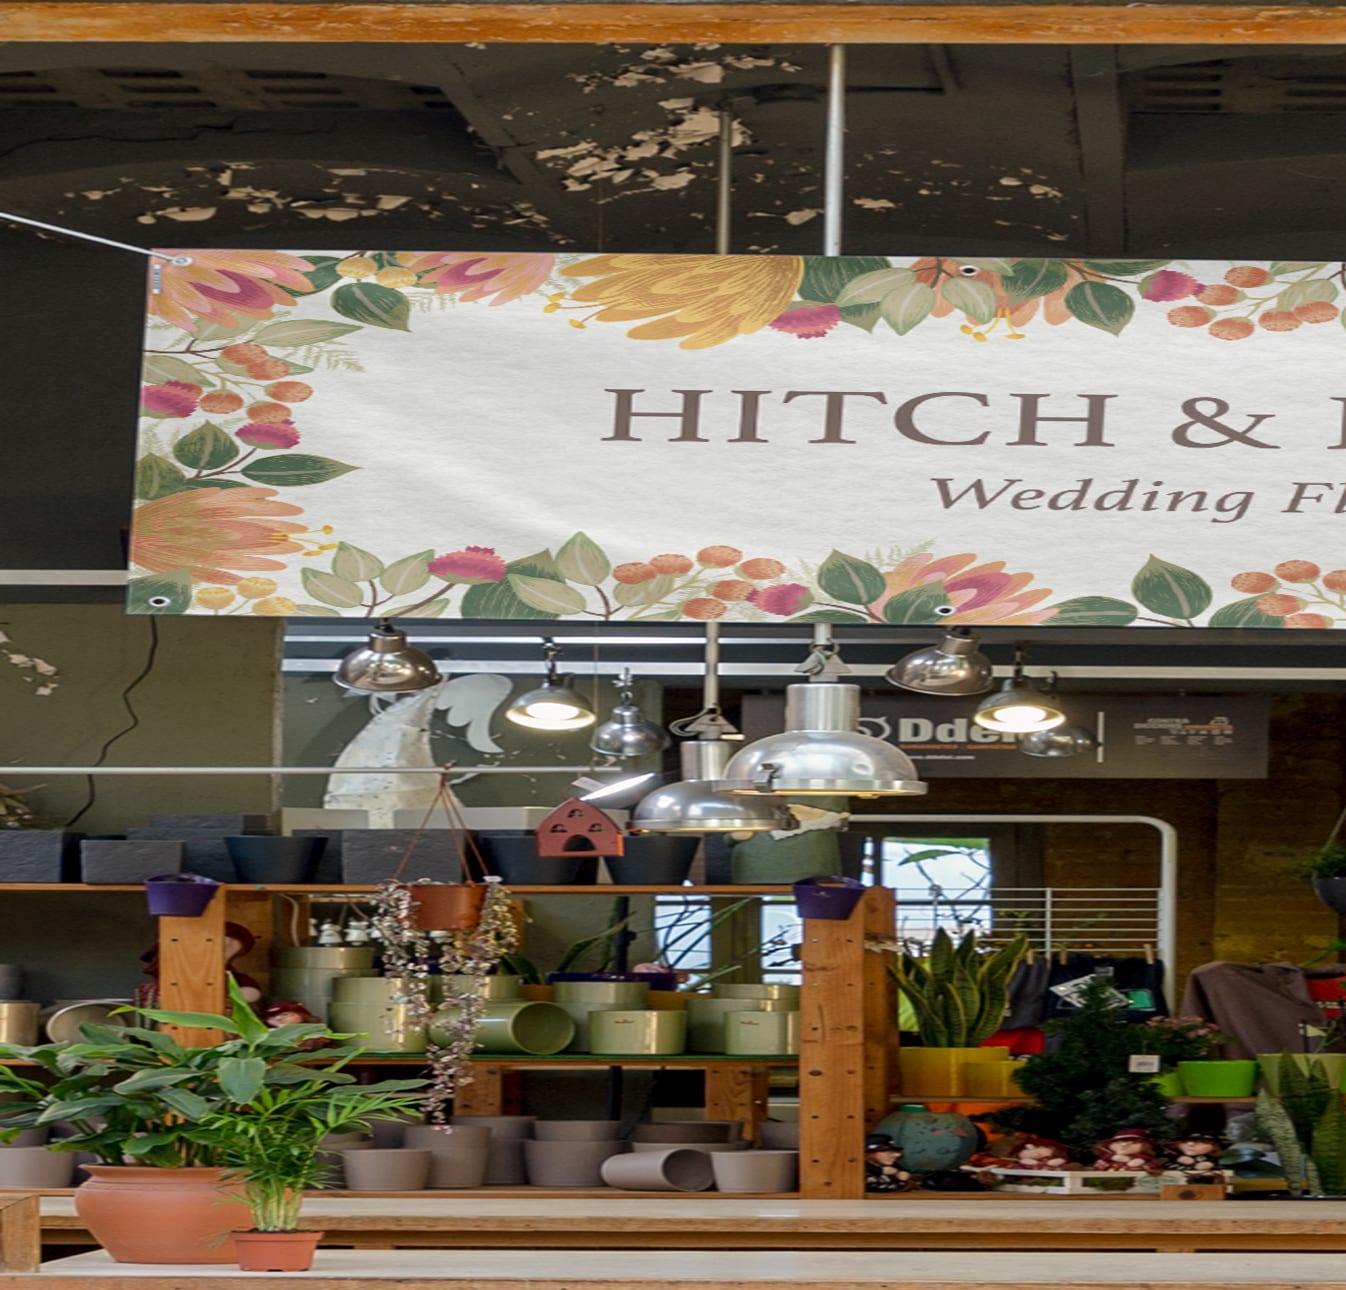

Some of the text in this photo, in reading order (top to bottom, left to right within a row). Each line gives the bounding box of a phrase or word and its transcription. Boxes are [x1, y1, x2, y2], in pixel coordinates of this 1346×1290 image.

[600, 388, 1119, 448] HITCH
[1171, 396, 1281, 450] &
[930, 477, 1255, 524] Wedding
